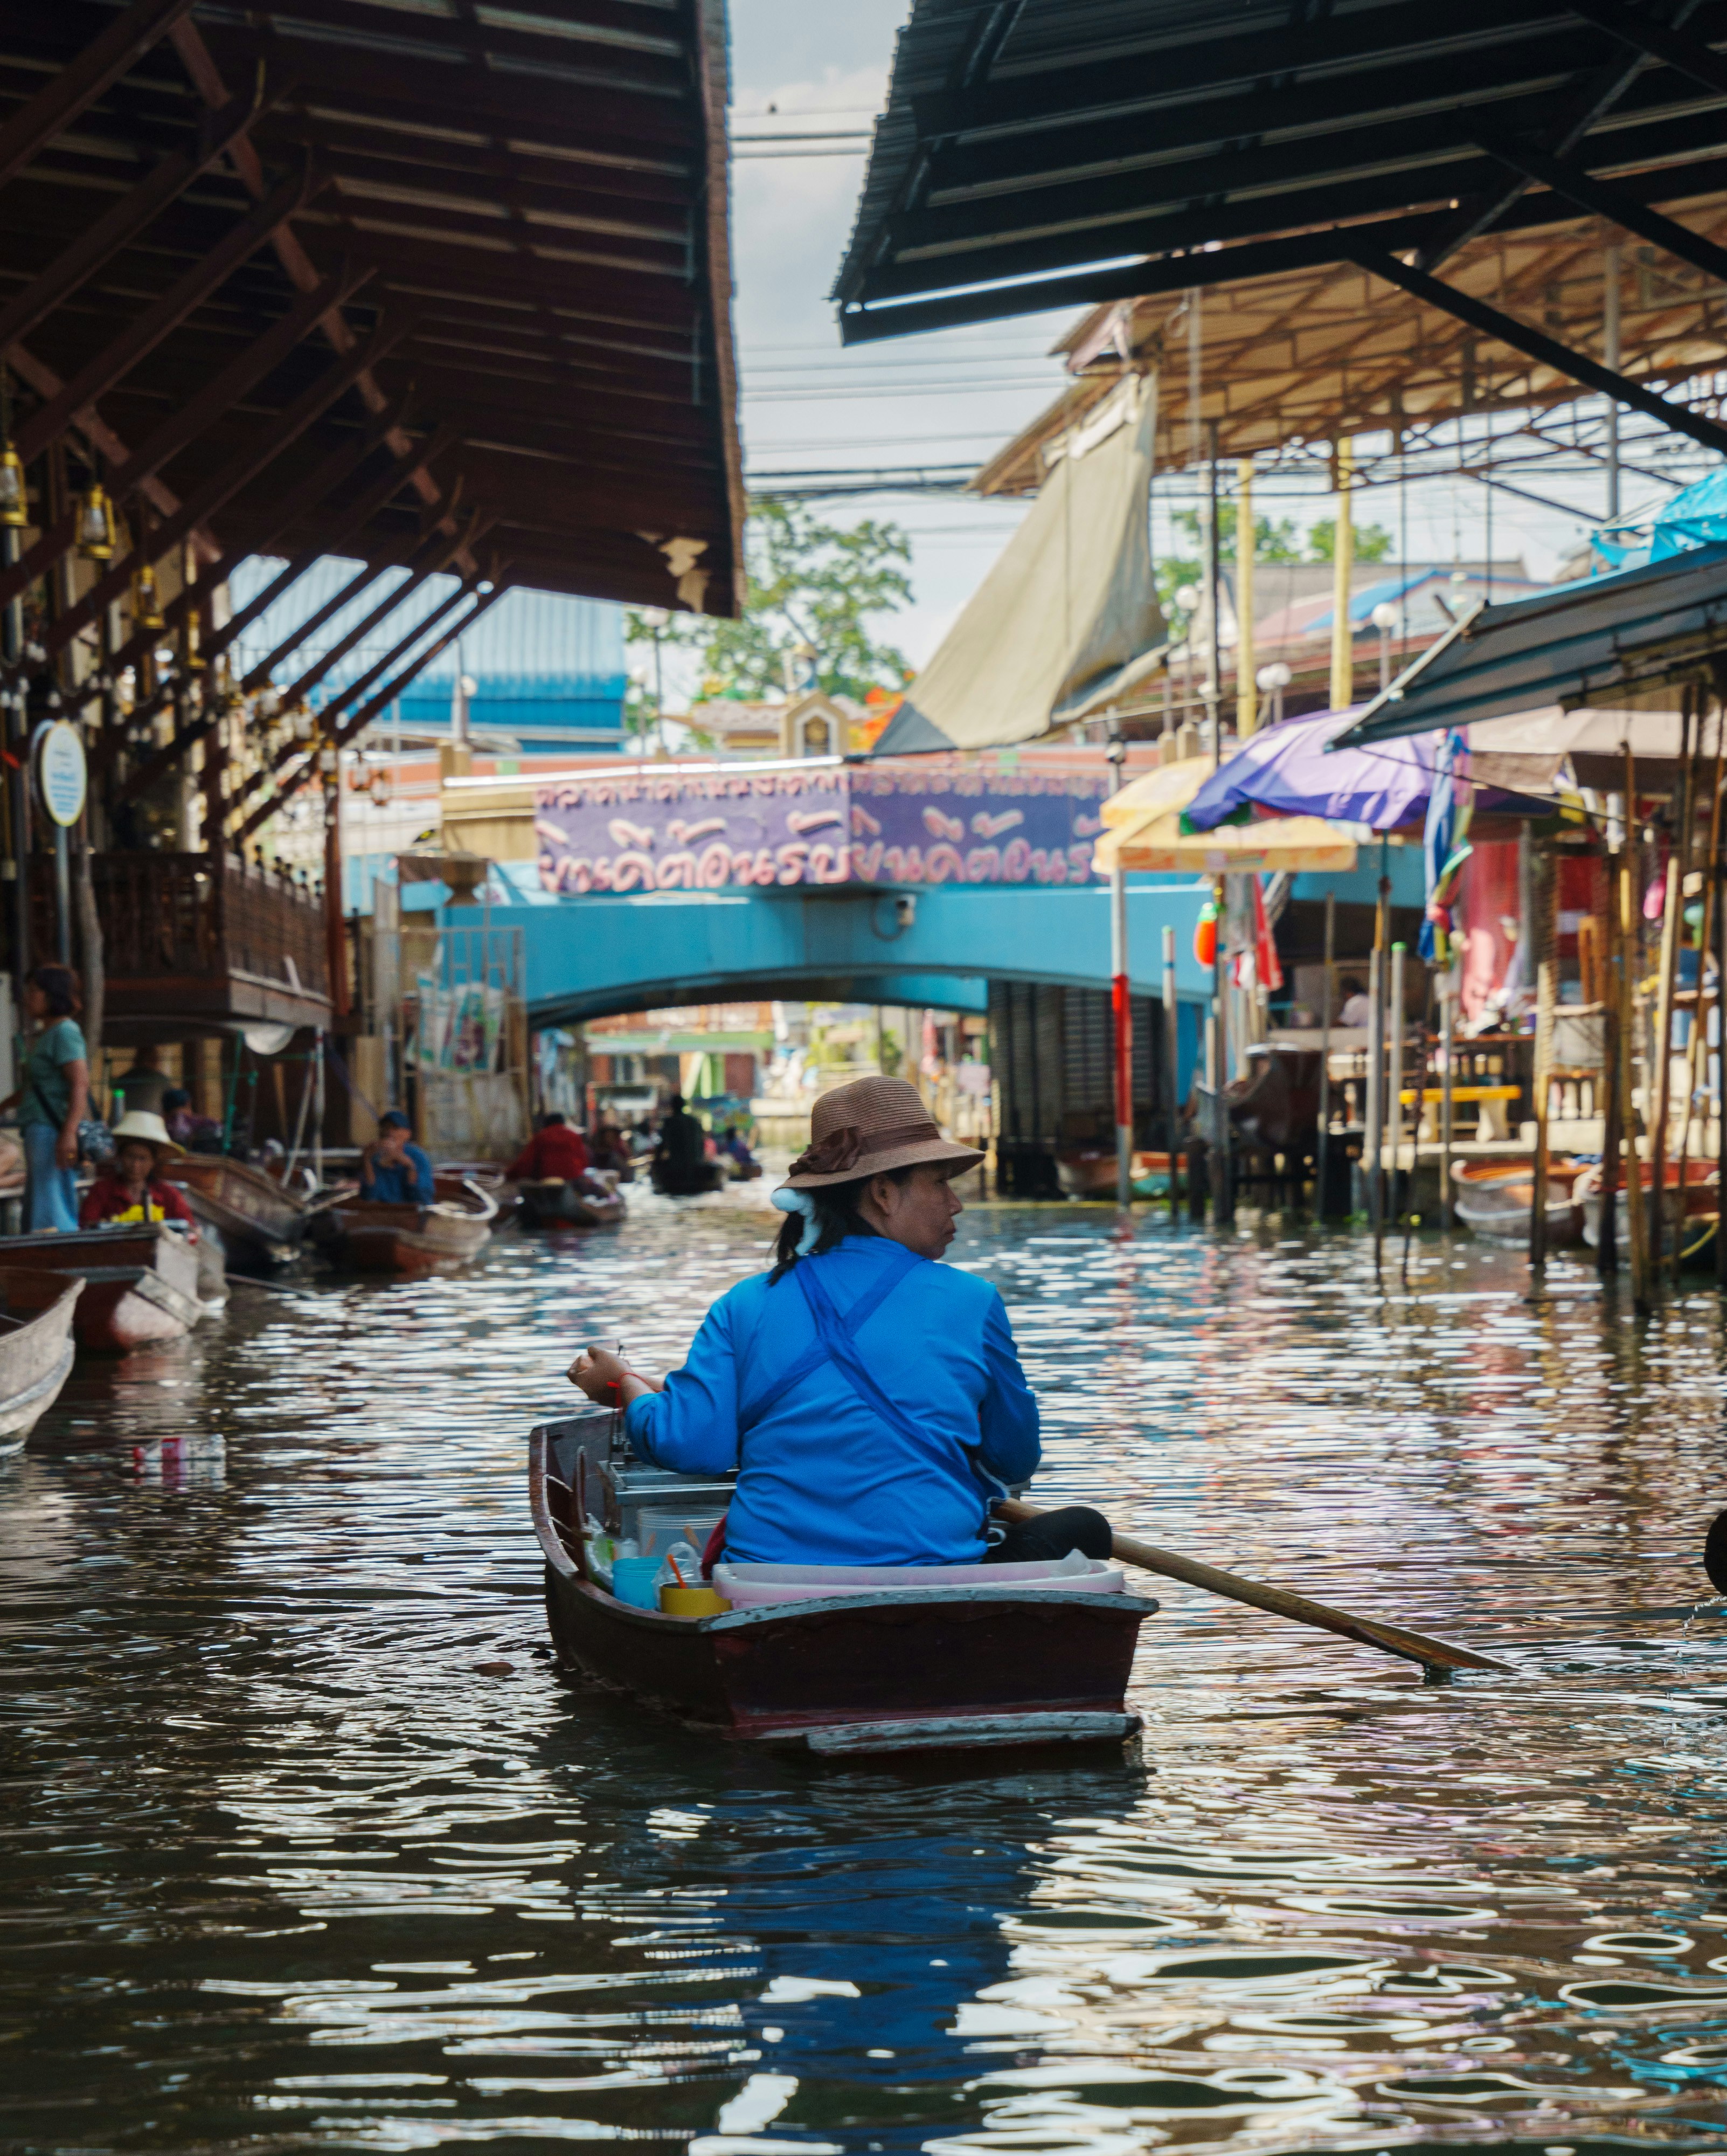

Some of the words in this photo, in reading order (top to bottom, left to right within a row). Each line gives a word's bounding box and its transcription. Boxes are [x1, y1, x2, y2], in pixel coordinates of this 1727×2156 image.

[850, 805, 1111, 884] ยินดีต้อนรั
